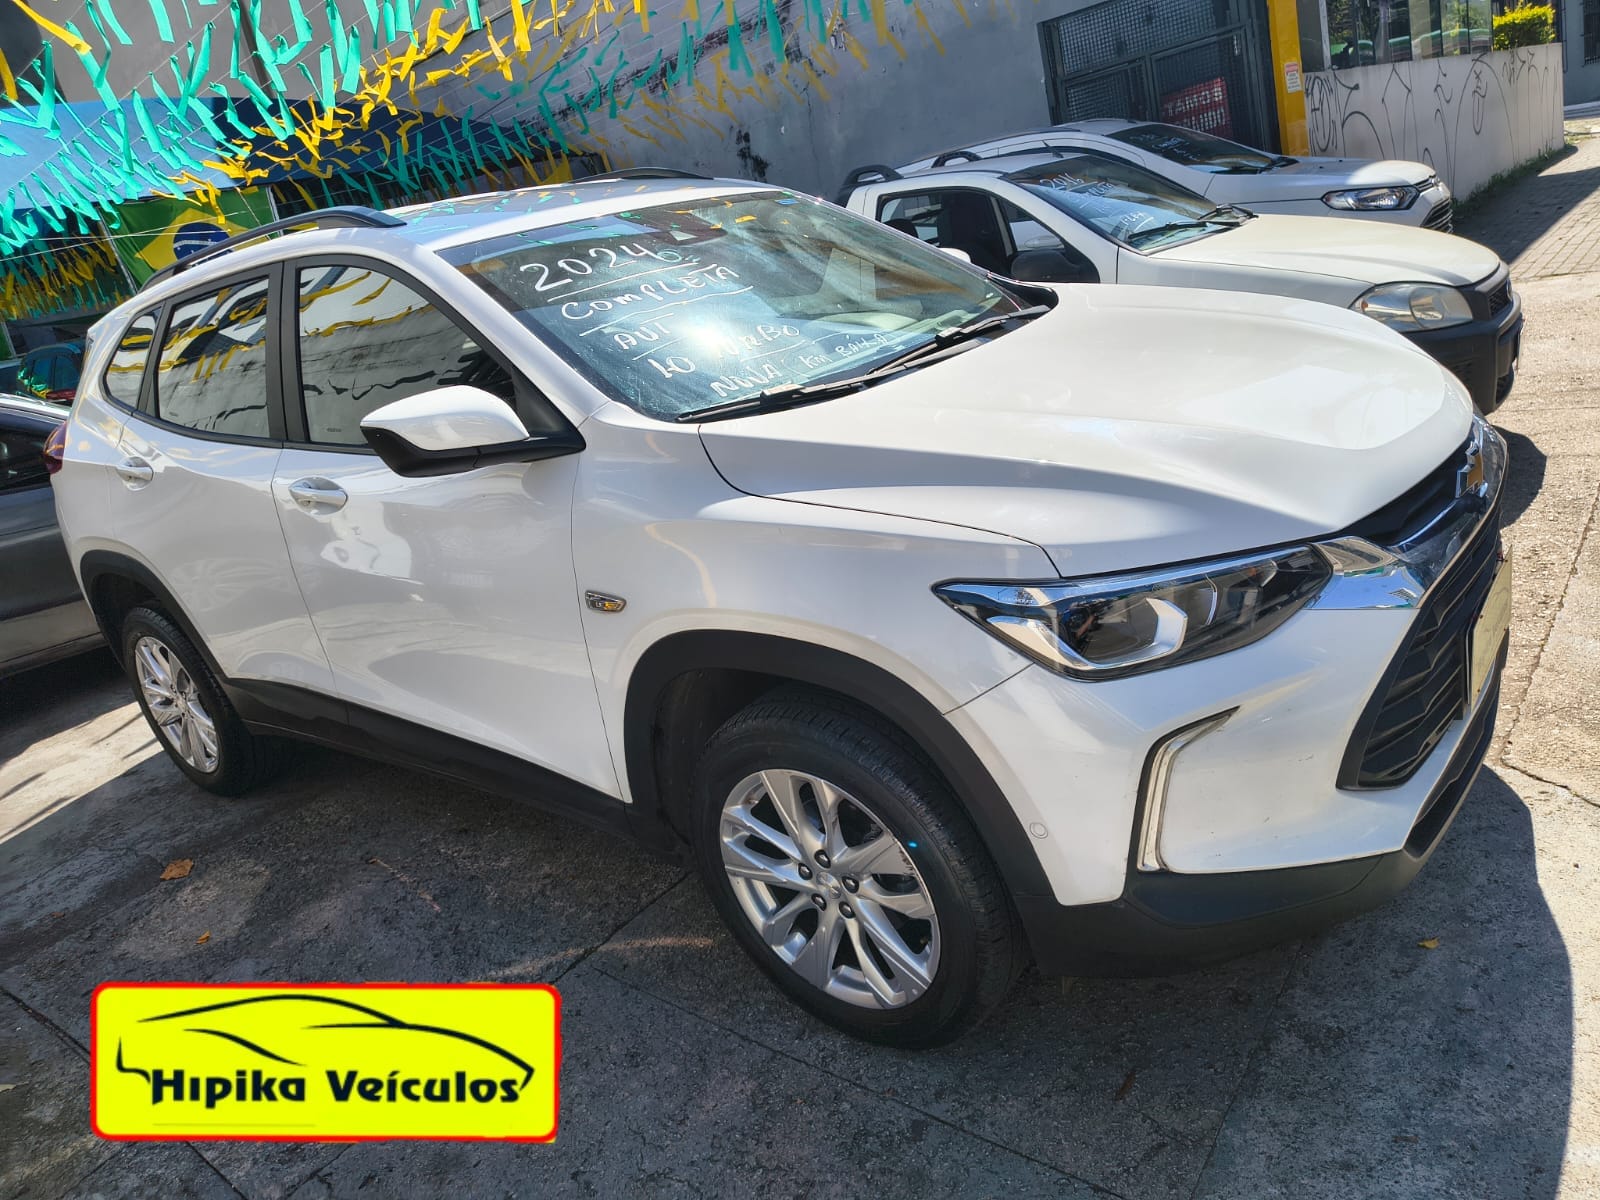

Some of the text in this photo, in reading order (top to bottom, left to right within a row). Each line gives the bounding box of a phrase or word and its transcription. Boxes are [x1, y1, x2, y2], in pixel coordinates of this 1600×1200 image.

[519, 243, 660, 292] 2024
[717, 324, 801, 357] URBO
[710, 361, 783, 397] NOVA
